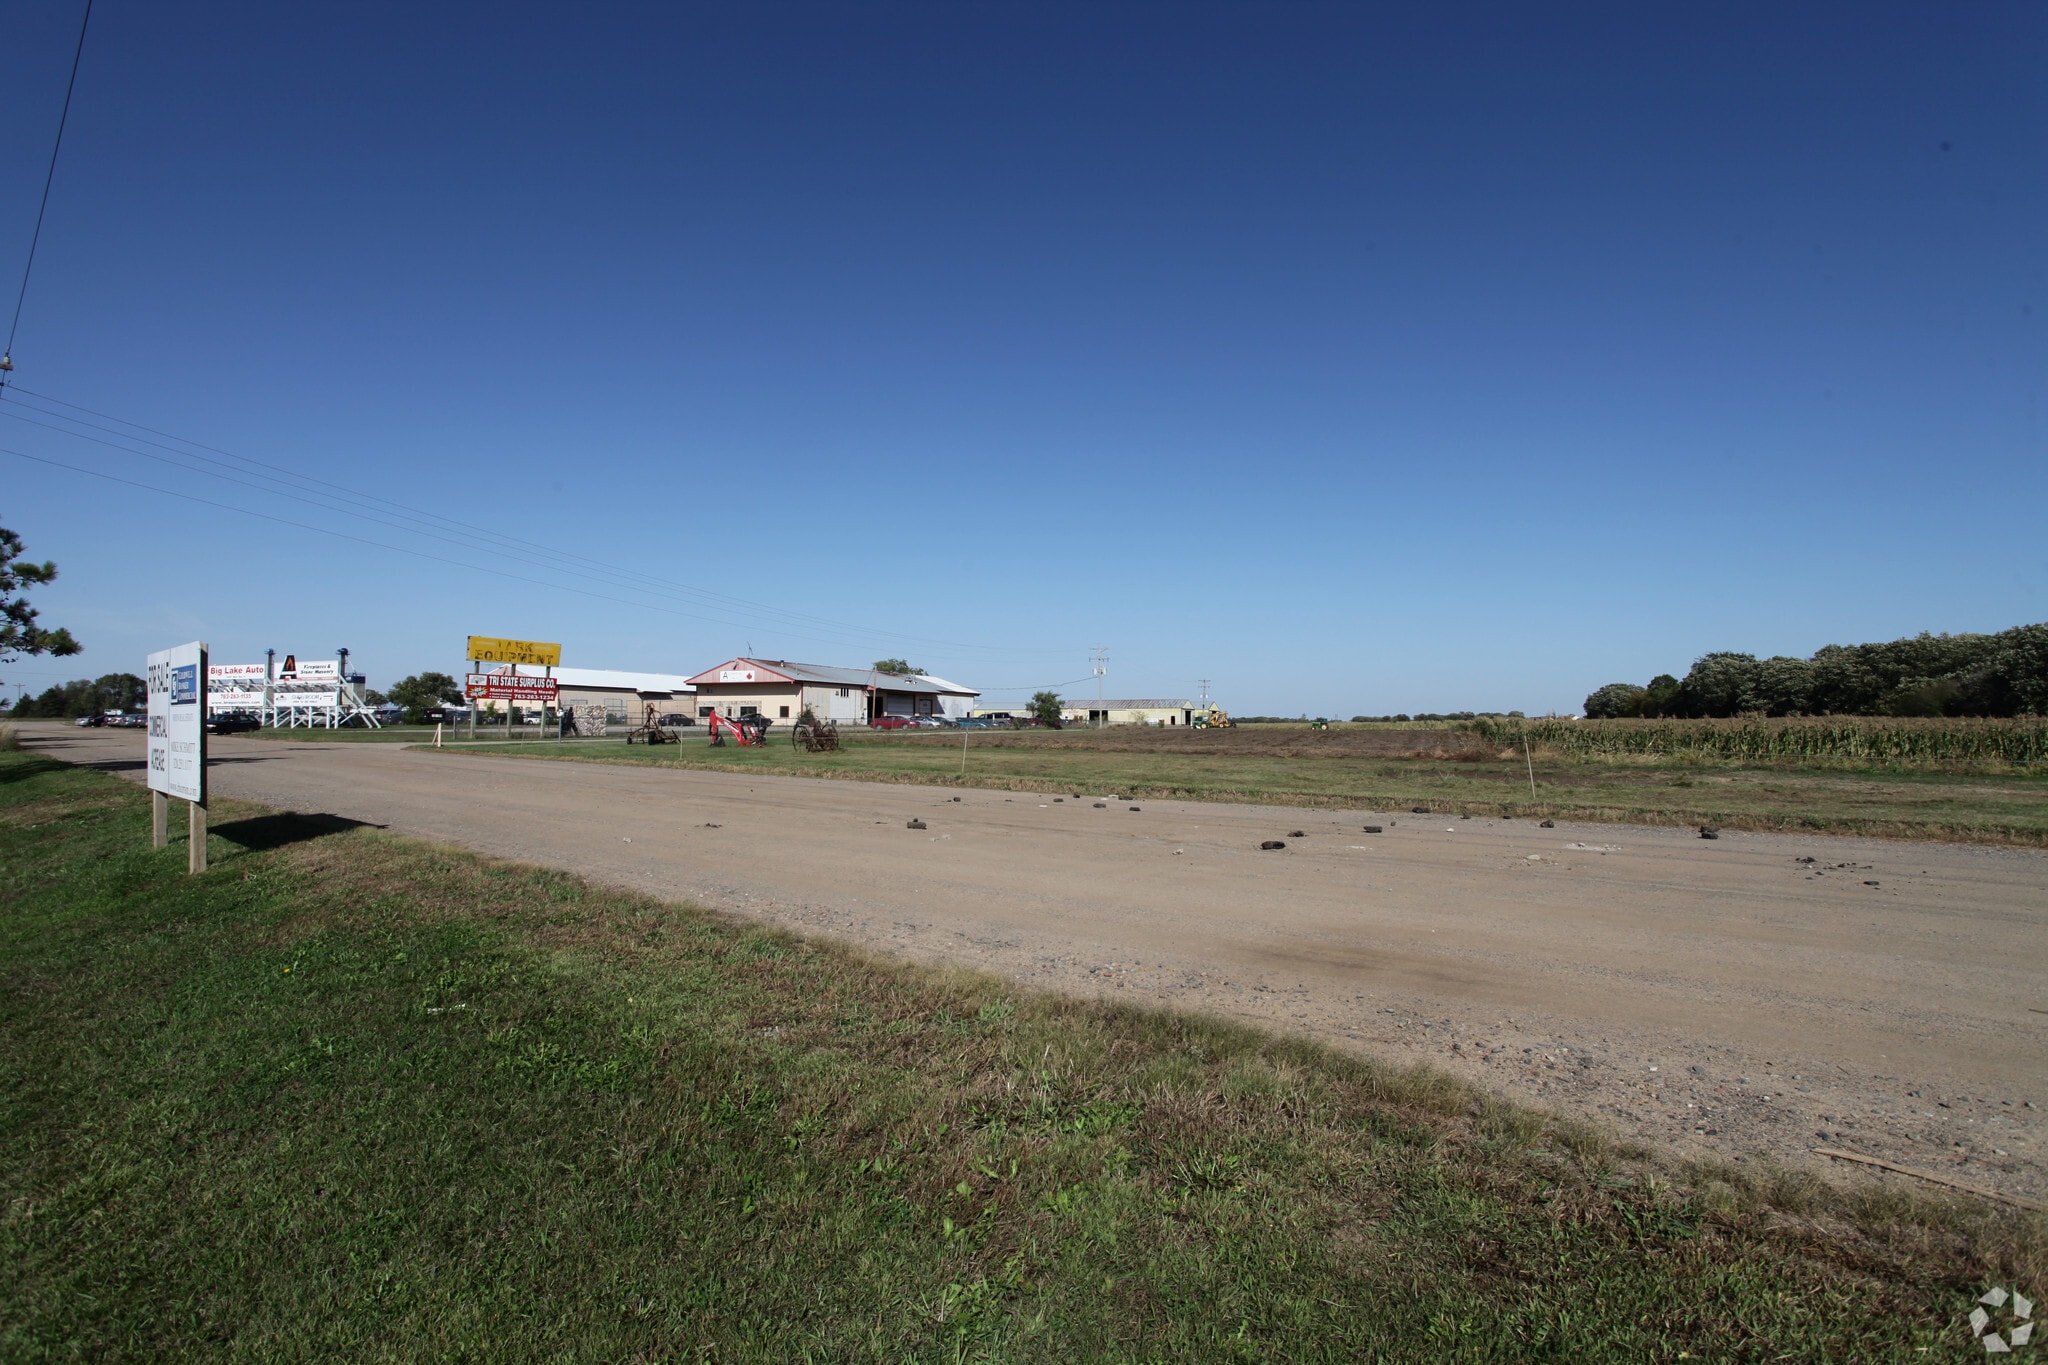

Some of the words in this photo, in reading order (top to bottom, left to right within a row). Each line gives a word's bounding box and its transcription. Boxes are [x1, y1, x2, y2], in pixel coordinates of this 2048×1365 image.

[474, 649, 554, 665] EQUIPMENT
[148, 664, 157, 694] FOR
[157, 662, 169, 694] SALE
[210, 667, 223, 676] Big
[722, 671, 729, 679] A
[488, 675, 500, 686] TRI
[500, 675, 519, 687] STATE
[519, 676, 545, 688] SURPLUS
[545, 678, 556, 689] CO.
